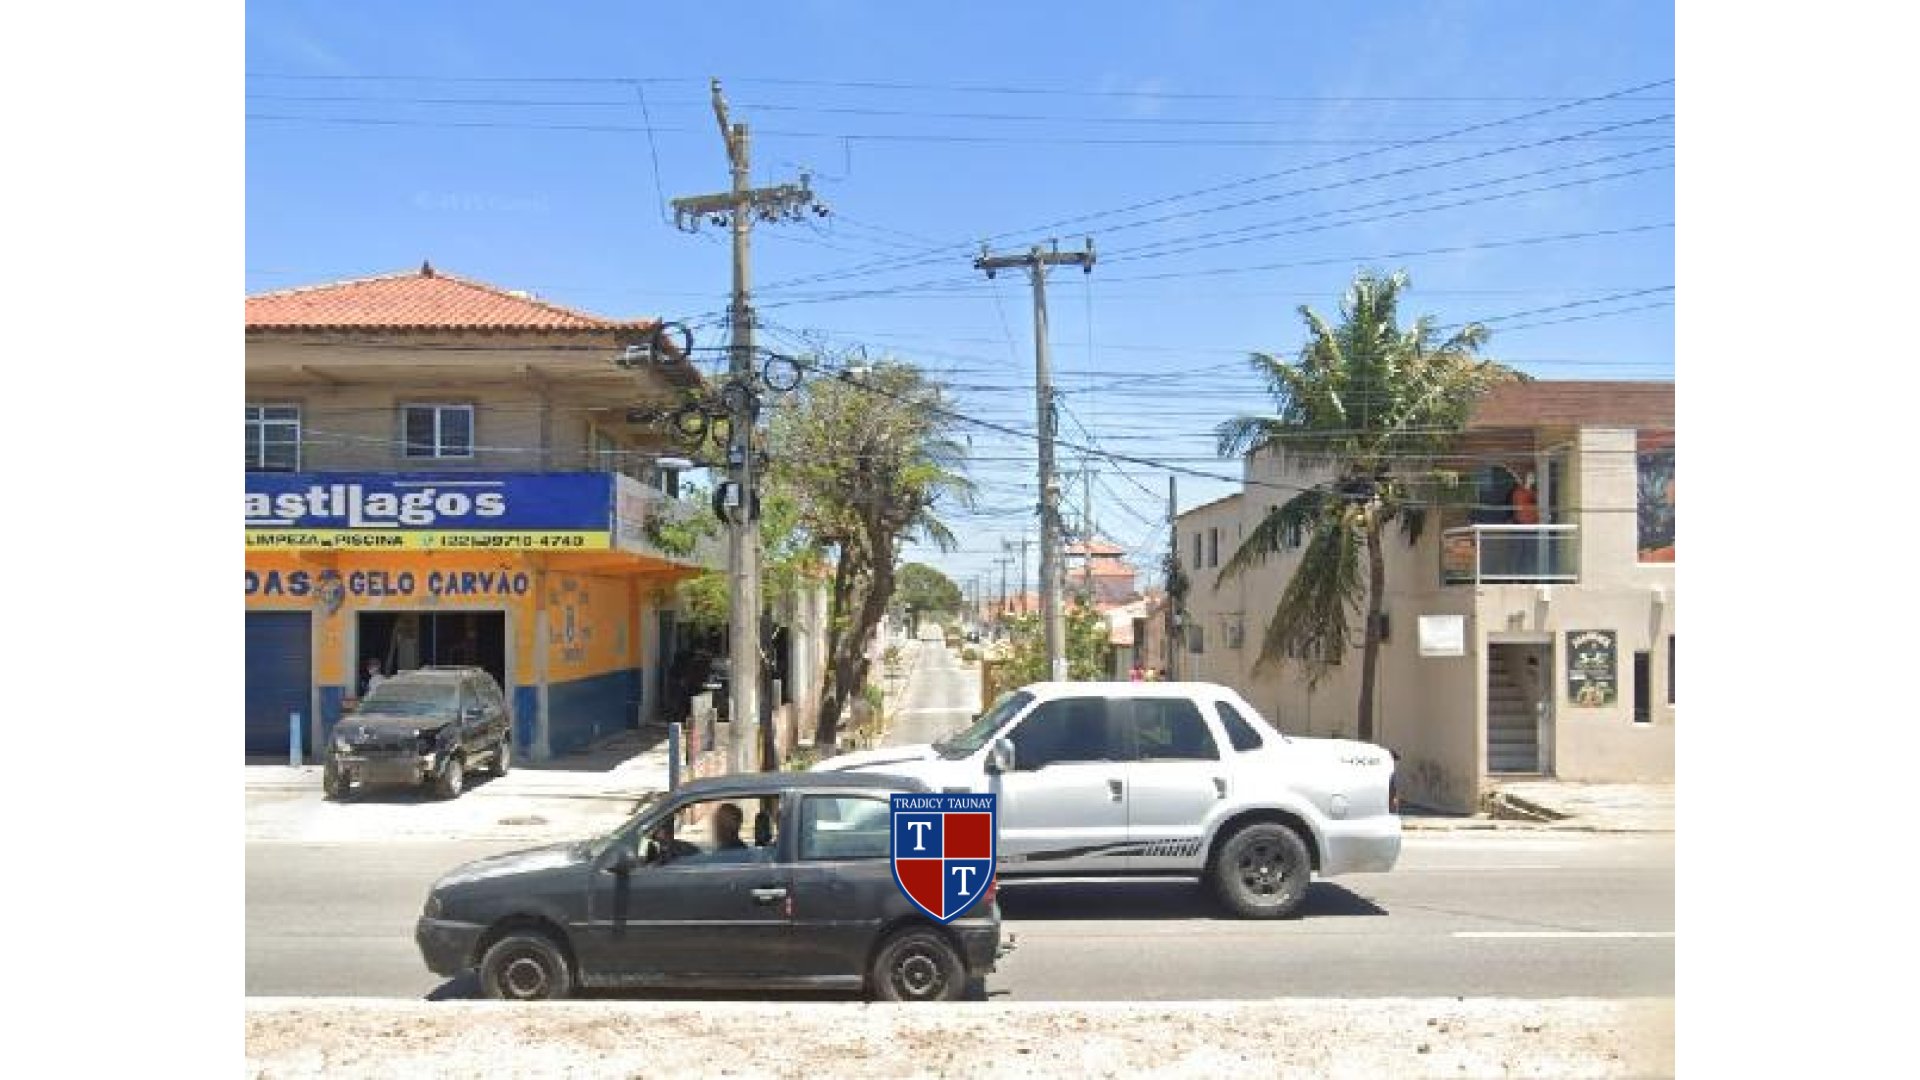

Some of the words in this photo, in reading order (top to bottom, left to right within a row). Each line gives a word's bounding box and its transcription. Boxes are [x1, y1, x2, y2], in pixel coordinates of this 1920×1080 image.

[246, 534, 319, 547] LIMPEZA
[335, 534, 403, 547] PISCINA
[349, 571, 415, 596] GELO
